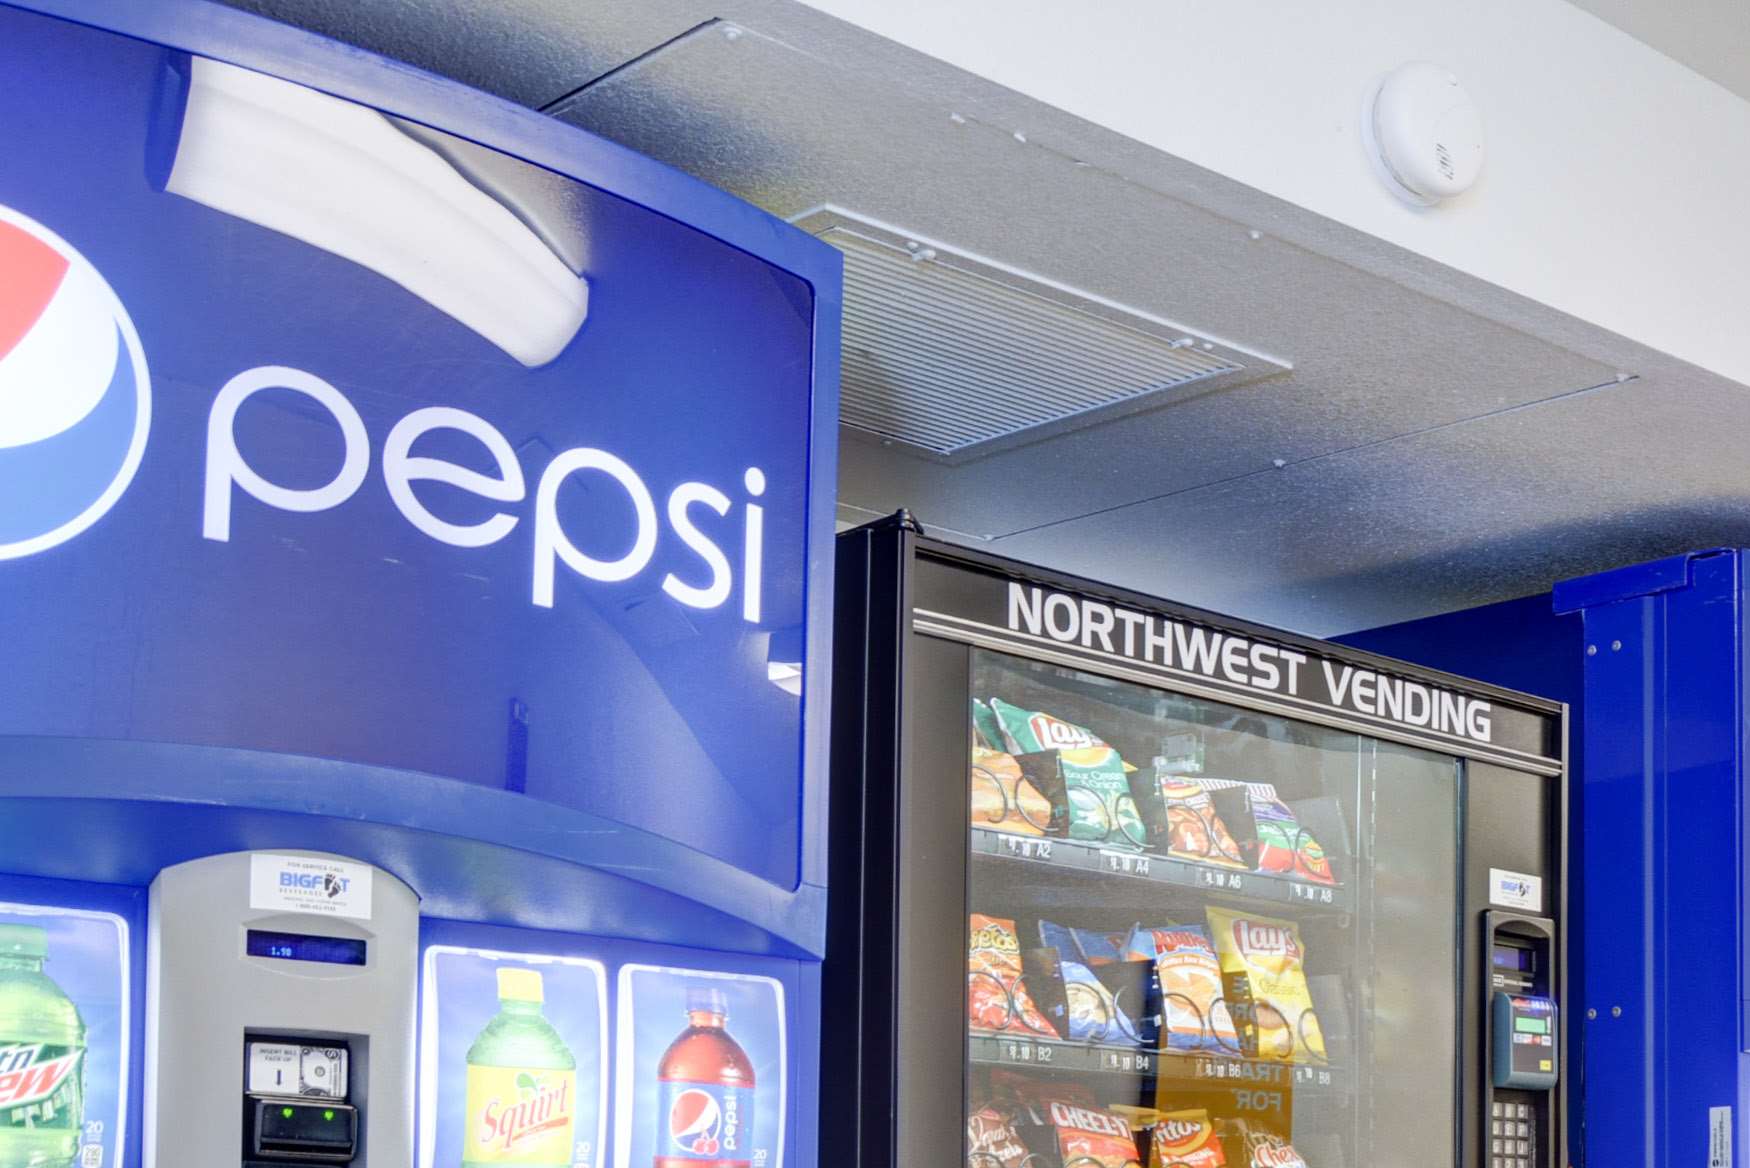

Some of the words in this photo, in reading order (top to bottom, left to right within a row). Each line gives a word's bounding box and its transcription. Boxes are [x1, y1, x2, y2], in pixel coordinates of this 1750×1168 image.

[202, 364, 766, 624] pepsi
[1007, 583, 1306, 696] NORTHWEST
[1322, 659, 1493, 742] VENDING
[1238, 919, 1296, 957] Lay's
[481, 1079, 568, 1147] Squirt
[723, 1095, 737, 1151] pepsi
